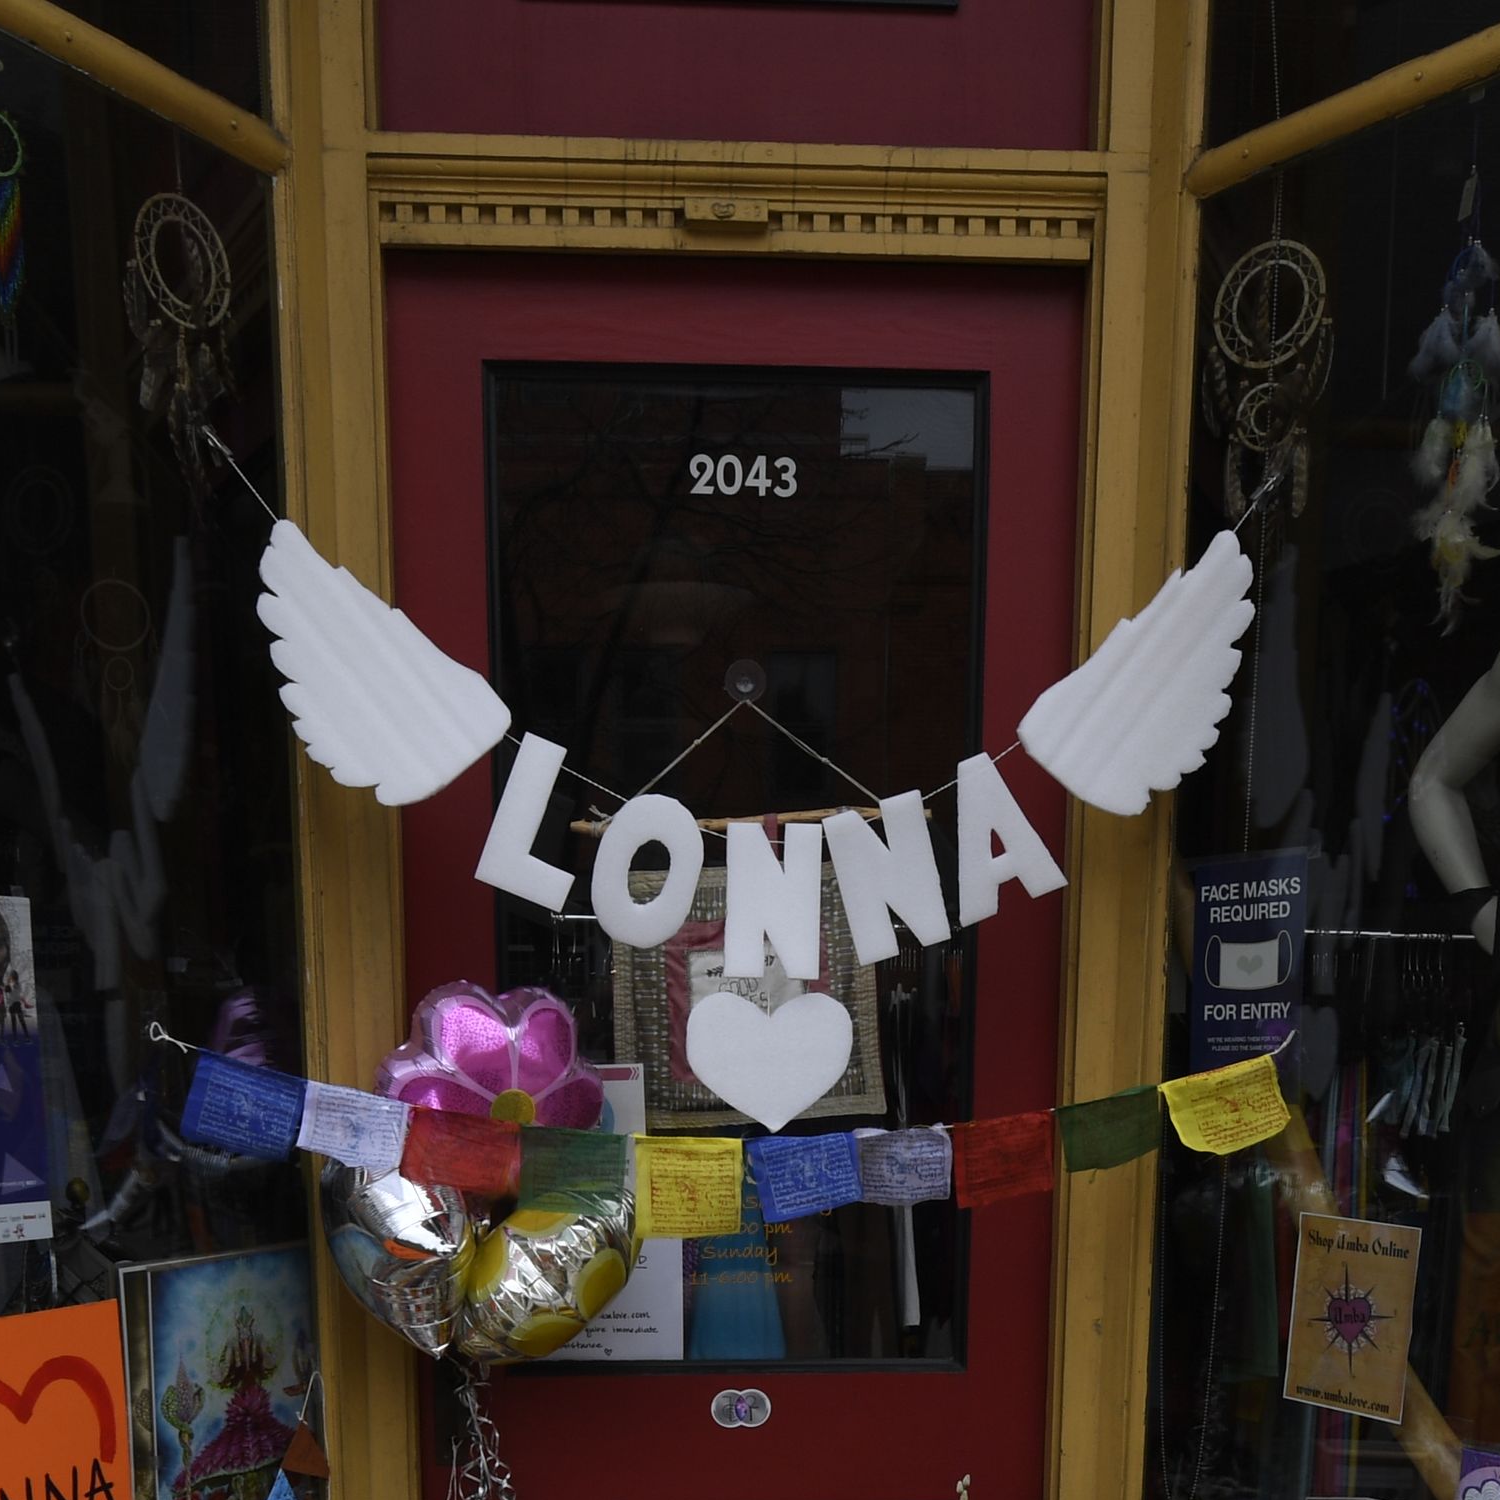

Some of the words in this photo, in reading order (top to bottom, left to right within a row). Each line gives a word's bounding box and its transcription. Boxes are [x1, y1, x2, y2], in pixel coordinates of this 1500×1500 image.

[689, 454, 799, 499] 2043
[475, 732, 1068, 980] LONNA
[1200, 882, 1240, 903] FACE
[1243, 876, 1301, 899] MASKS
[1209, 900, 1291, 924] REQUIRED
[1203, 1003, 1237, 1022] FOR
[1240, 1001, 1291, 1020] ENTRY
[700, 1245, 780, 1265] Sunday
[1308, 1229, 1334, 1254] Shop
[1372, 1237, 1410, 1260] Online
[763, 1271, 794, 1290] pm
[1296, 1385, 1390, 1414] www.umbalove.com
